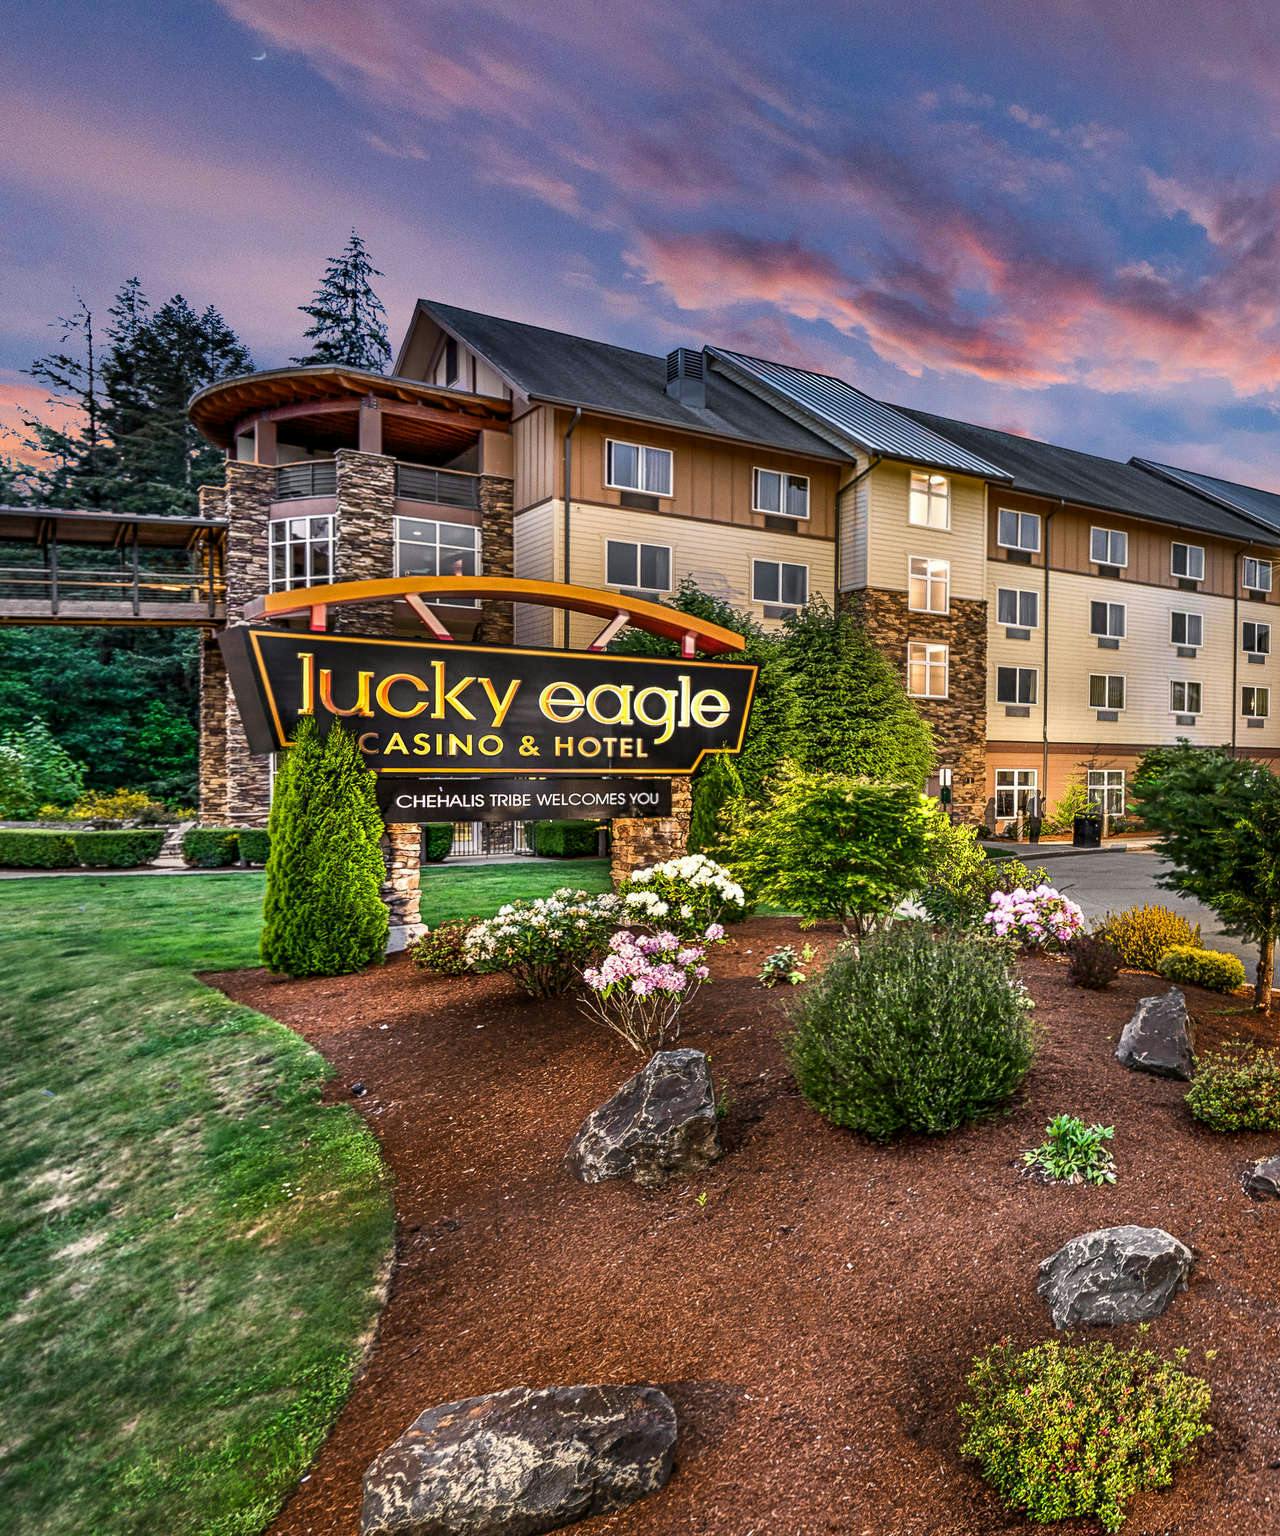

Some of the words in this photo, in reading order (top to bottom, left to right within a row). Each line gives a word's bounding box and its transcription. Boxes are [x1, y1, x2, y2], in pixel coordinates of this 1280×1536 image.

[297, 652, 523, 728] lucky
[538, 675, 731, 745] eagle
[357, 731, 505, 757] CASINO
[518, 735, 541, 757] &
[554, 736, 649, 758] HOTEL
[396, 793, 485, 809] CHEHALIS
[489, 793, 532, 807] TRIBE
[536, 792, 626, 807] WELCOMES
[629, 792, 660, 806] YOU
